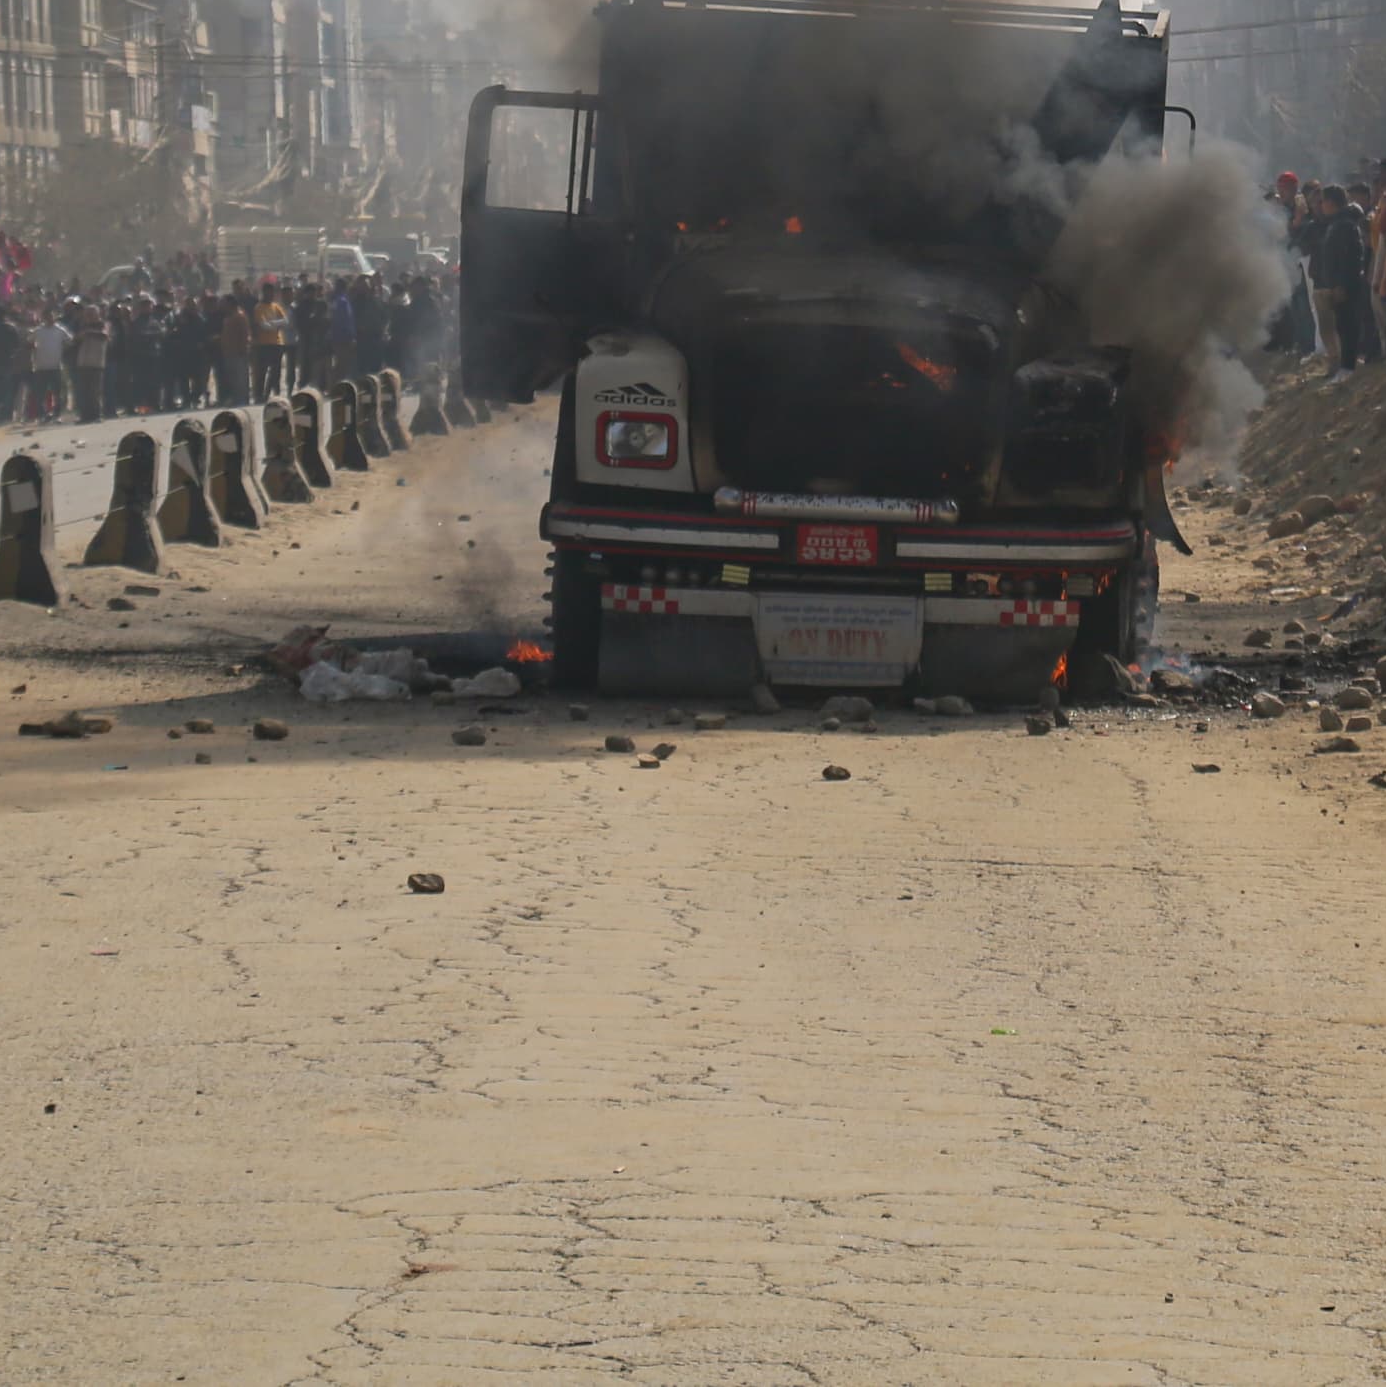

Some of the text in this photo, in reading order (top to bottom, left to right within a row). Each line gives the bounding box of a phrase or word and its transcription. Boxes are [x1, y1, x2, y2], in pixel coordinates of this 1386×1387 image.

[594, 394, 677, 407] adidas
[788, 628, 886, 659] ON DUTY
